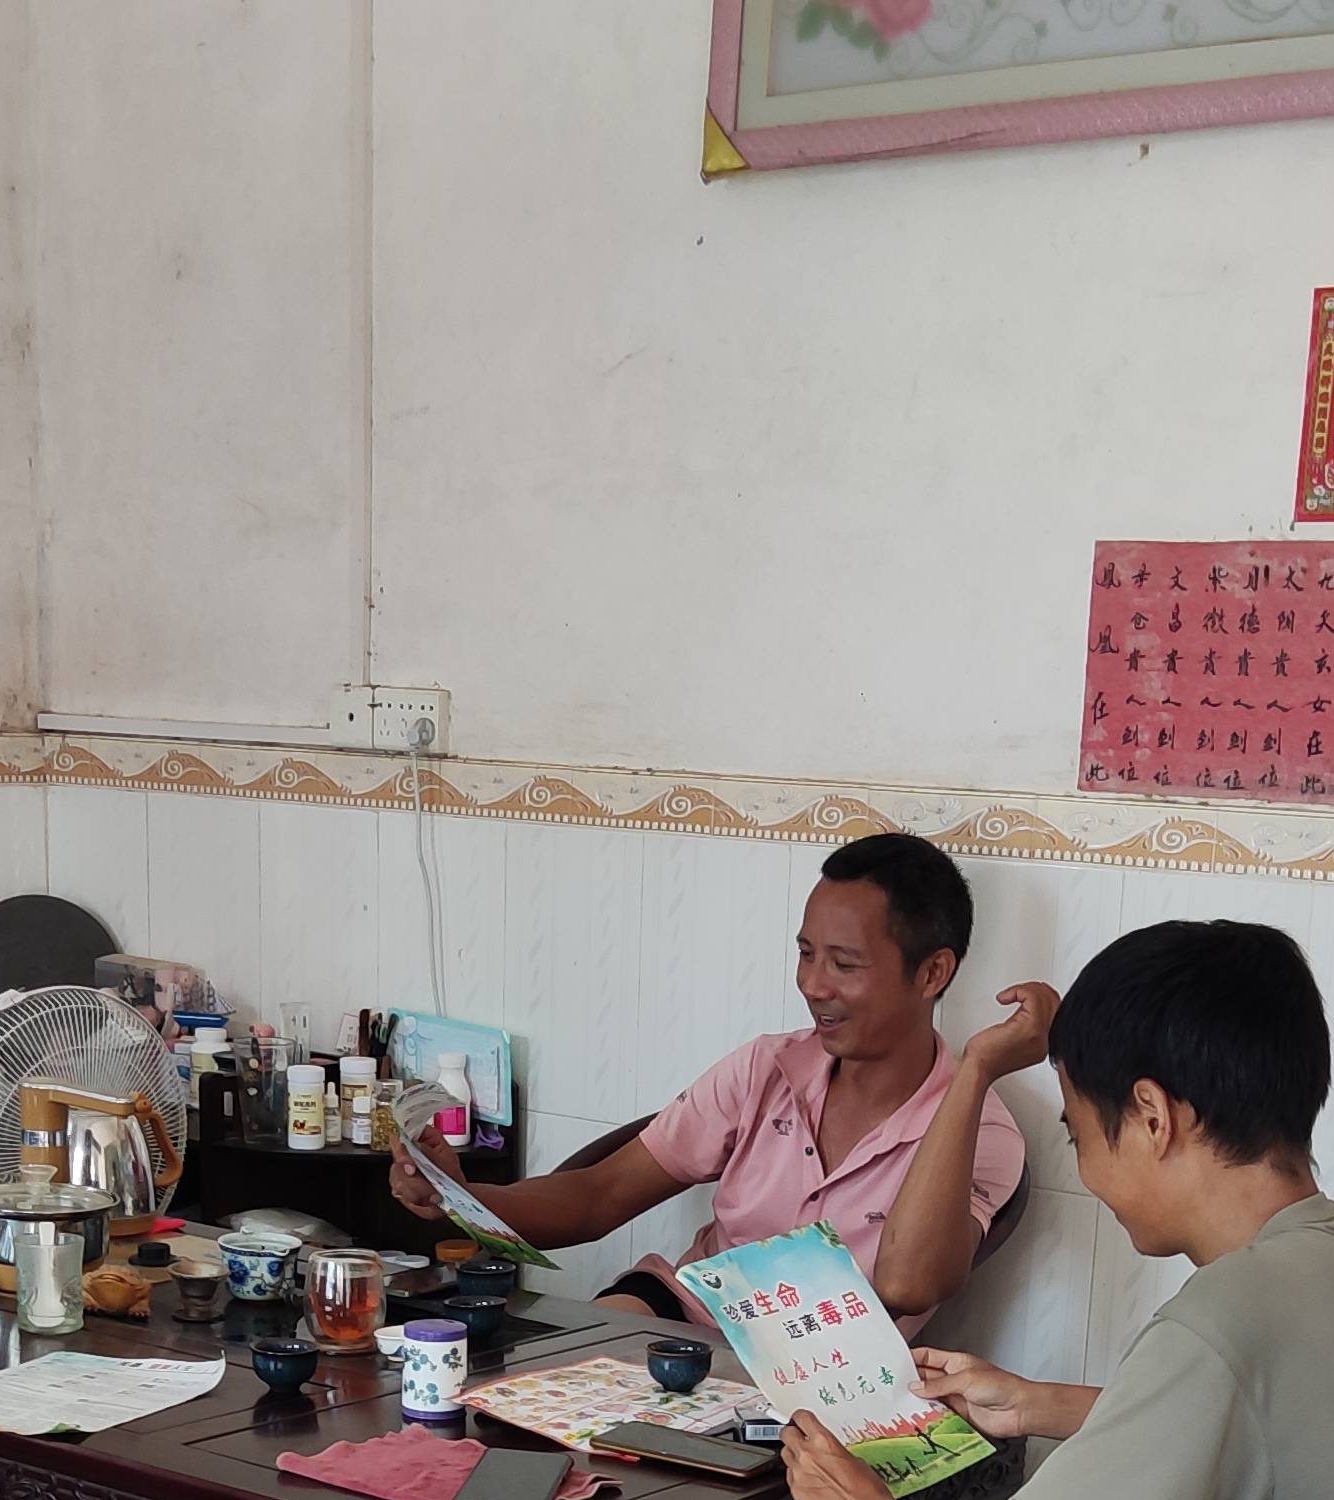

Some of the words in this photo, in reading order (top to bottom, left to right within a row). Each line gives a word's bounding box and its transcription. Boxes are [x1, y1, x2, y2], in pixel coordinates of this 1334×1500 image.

[723, 1281, 800, 1322] 珍爱生命
[782, 1291, 870, 1339] 远离毒品
[773, 1348, 850, 1387] 健康人生
